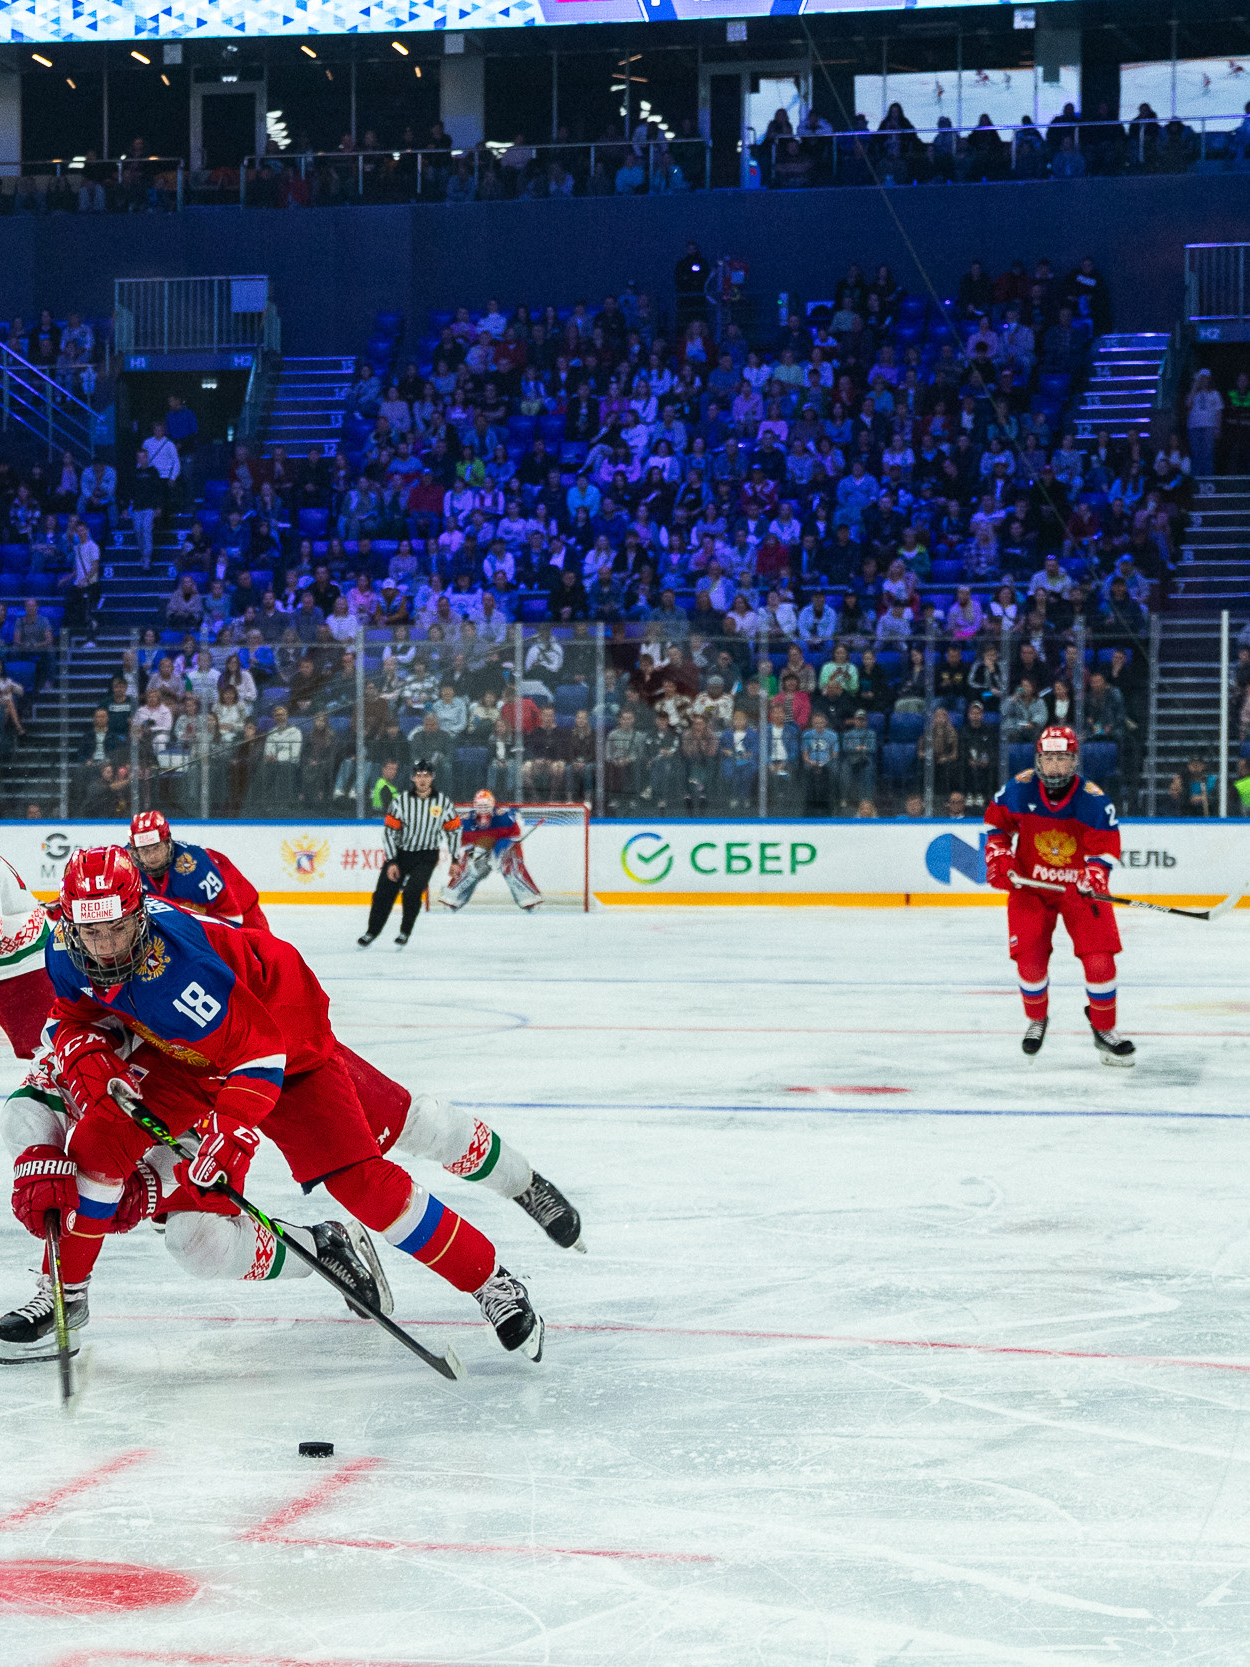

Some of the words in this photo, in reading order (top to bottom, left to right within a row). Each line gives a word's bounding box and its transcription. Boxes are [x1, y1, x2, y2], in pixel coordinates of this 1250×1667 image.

[689, 842, 818, 876] СБЕР
[198, 871, 223, 901] 29
[80, 902, 101, 912] RED
[80, 910, 113, 919] MACHINE
[172, 981, 222, 1029] 18
